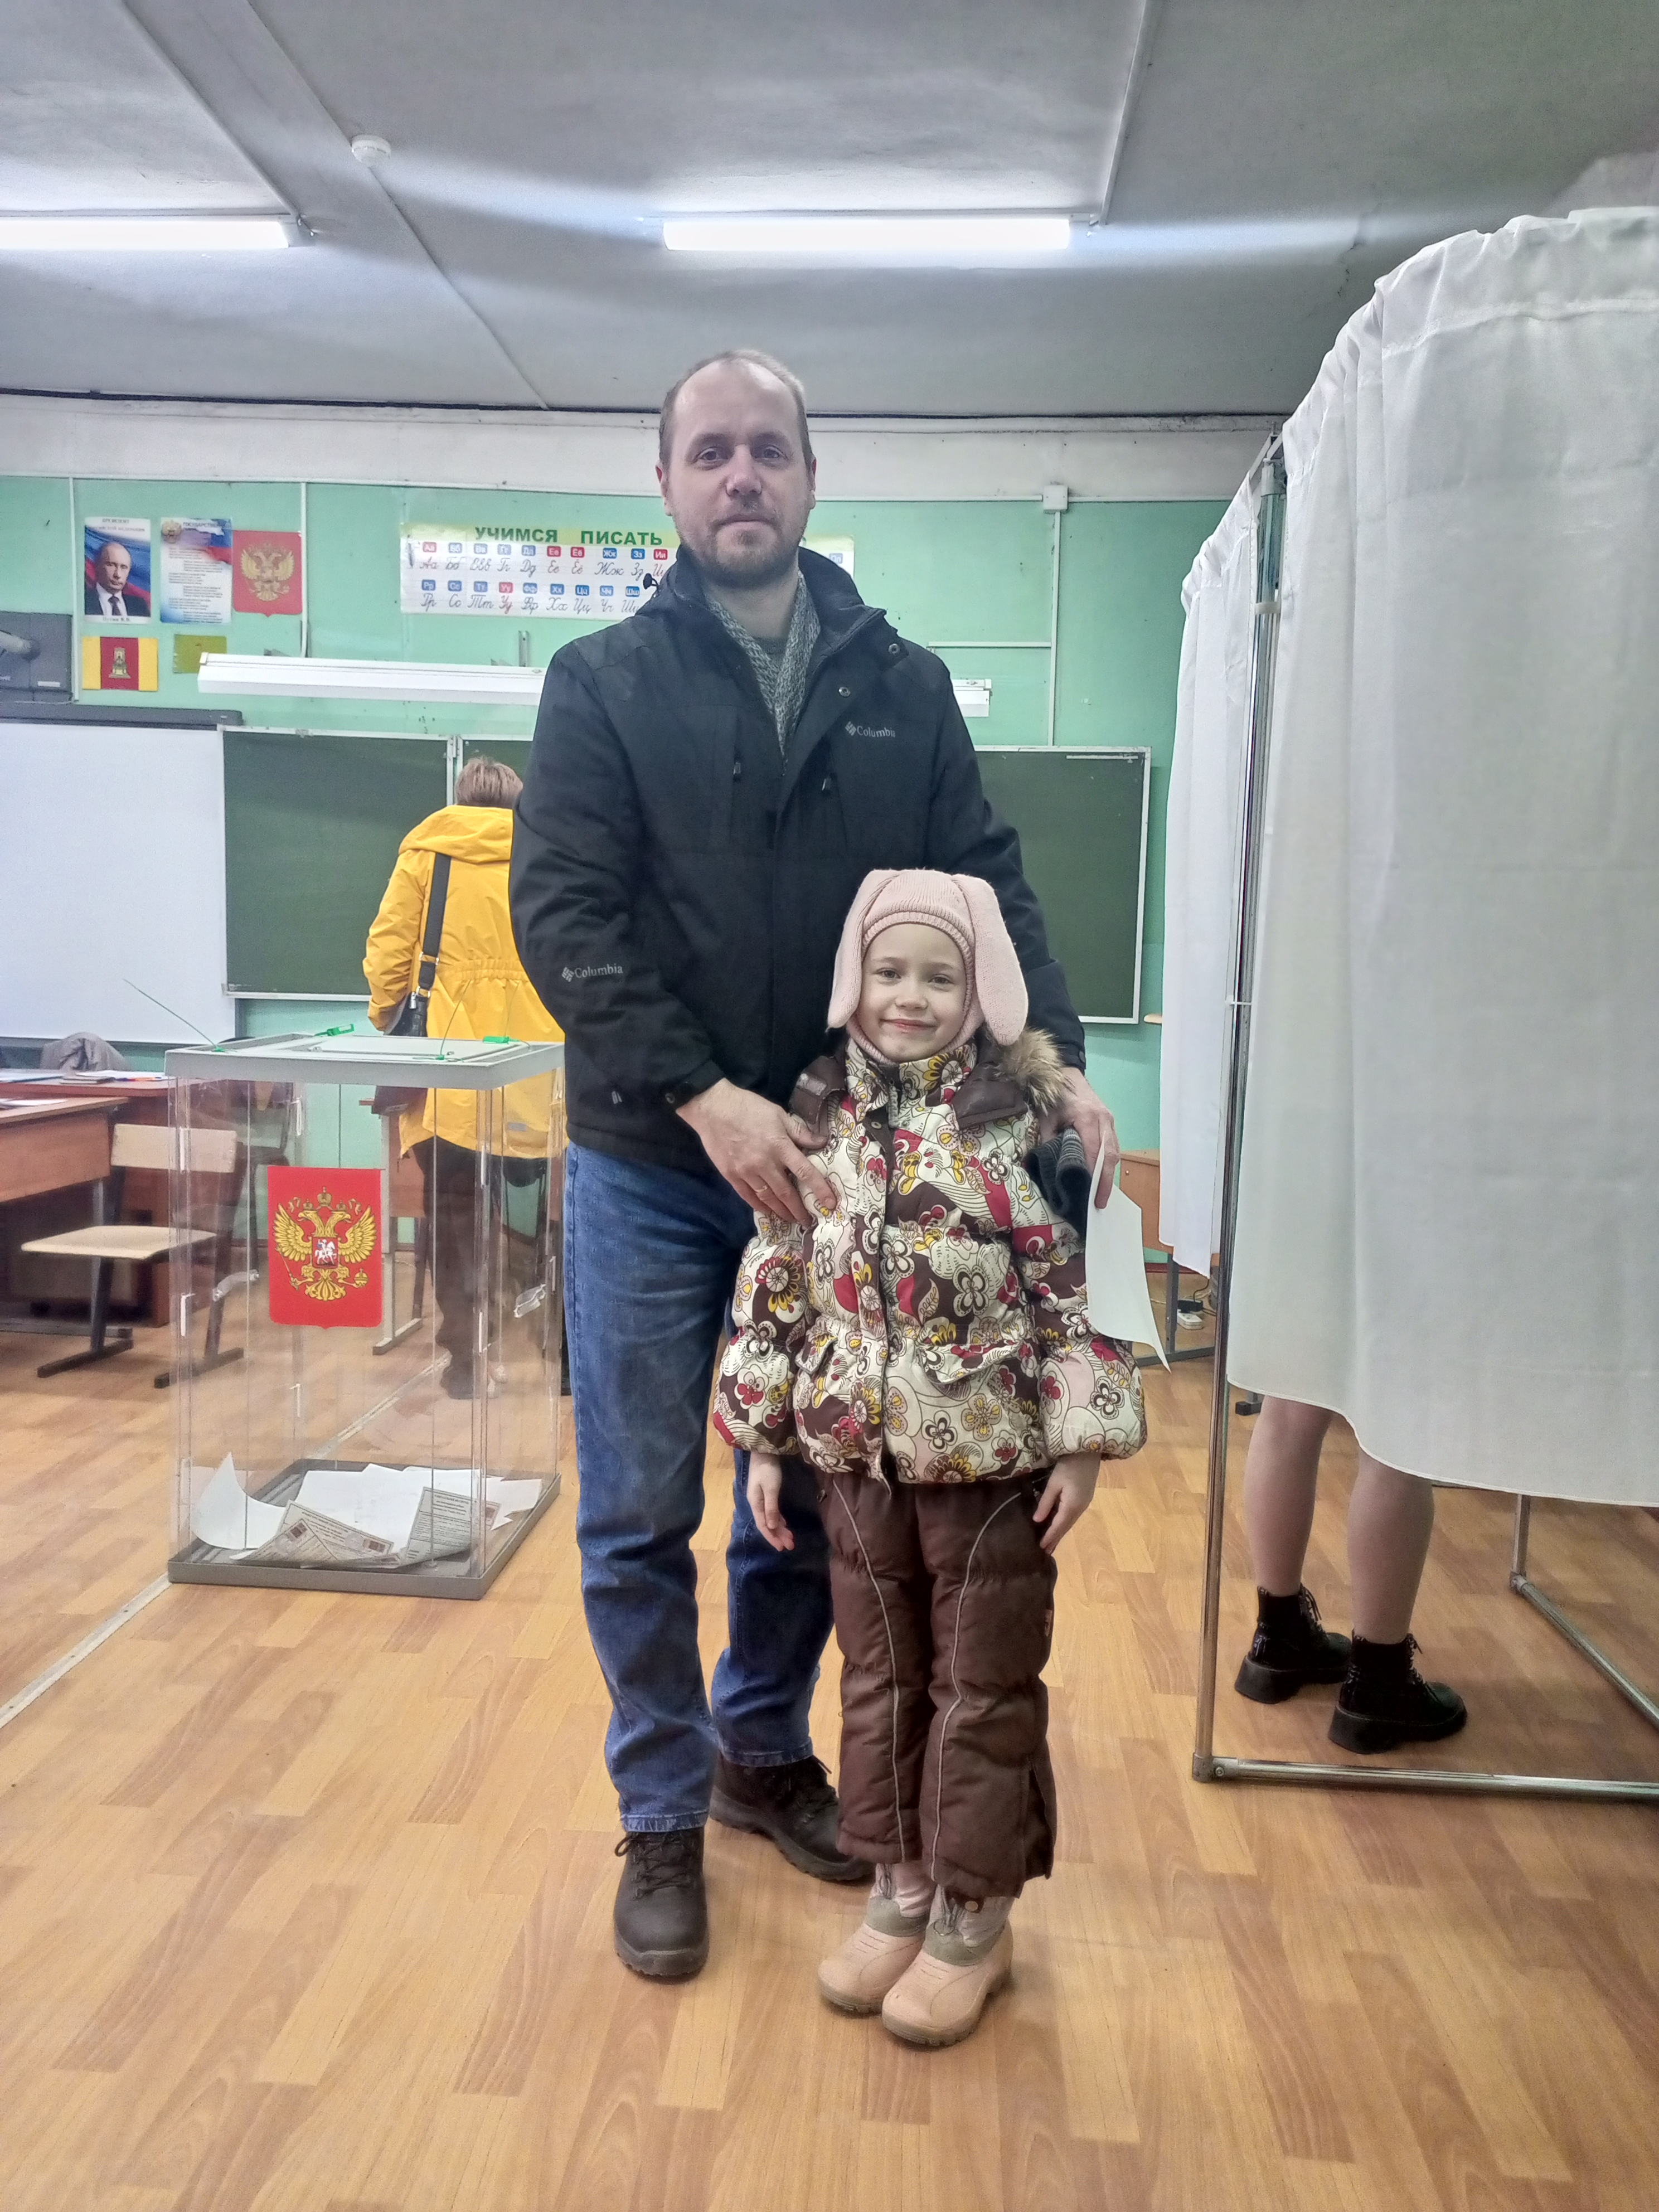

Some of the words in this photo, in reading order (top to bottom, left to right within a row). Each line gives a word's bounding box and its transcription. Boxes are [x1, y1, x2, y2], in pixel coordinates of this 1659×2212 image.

[475, 526, 557, 543] УЧИМСЯ
[581, 530, 662, 546] ПИСАТЬ
[548, 547, 560, 556] Ее
[603, 549, 616, 557] Жж
[633, 550, 643, 558] Зз
[594, 562, 624, 575] Жж
[423, 581, 435, 591] Рр
[448, 582, 461, 590] Сс
[551, 585, 563, 594] Хх
[576, 586, 588, 595] Цц
[626, 587, 639, 595] Шш
[449, 594, 462, 608] Сс
[857, 725, 895, 738] Columbia
[574, 963, 623, 978] Columbia
